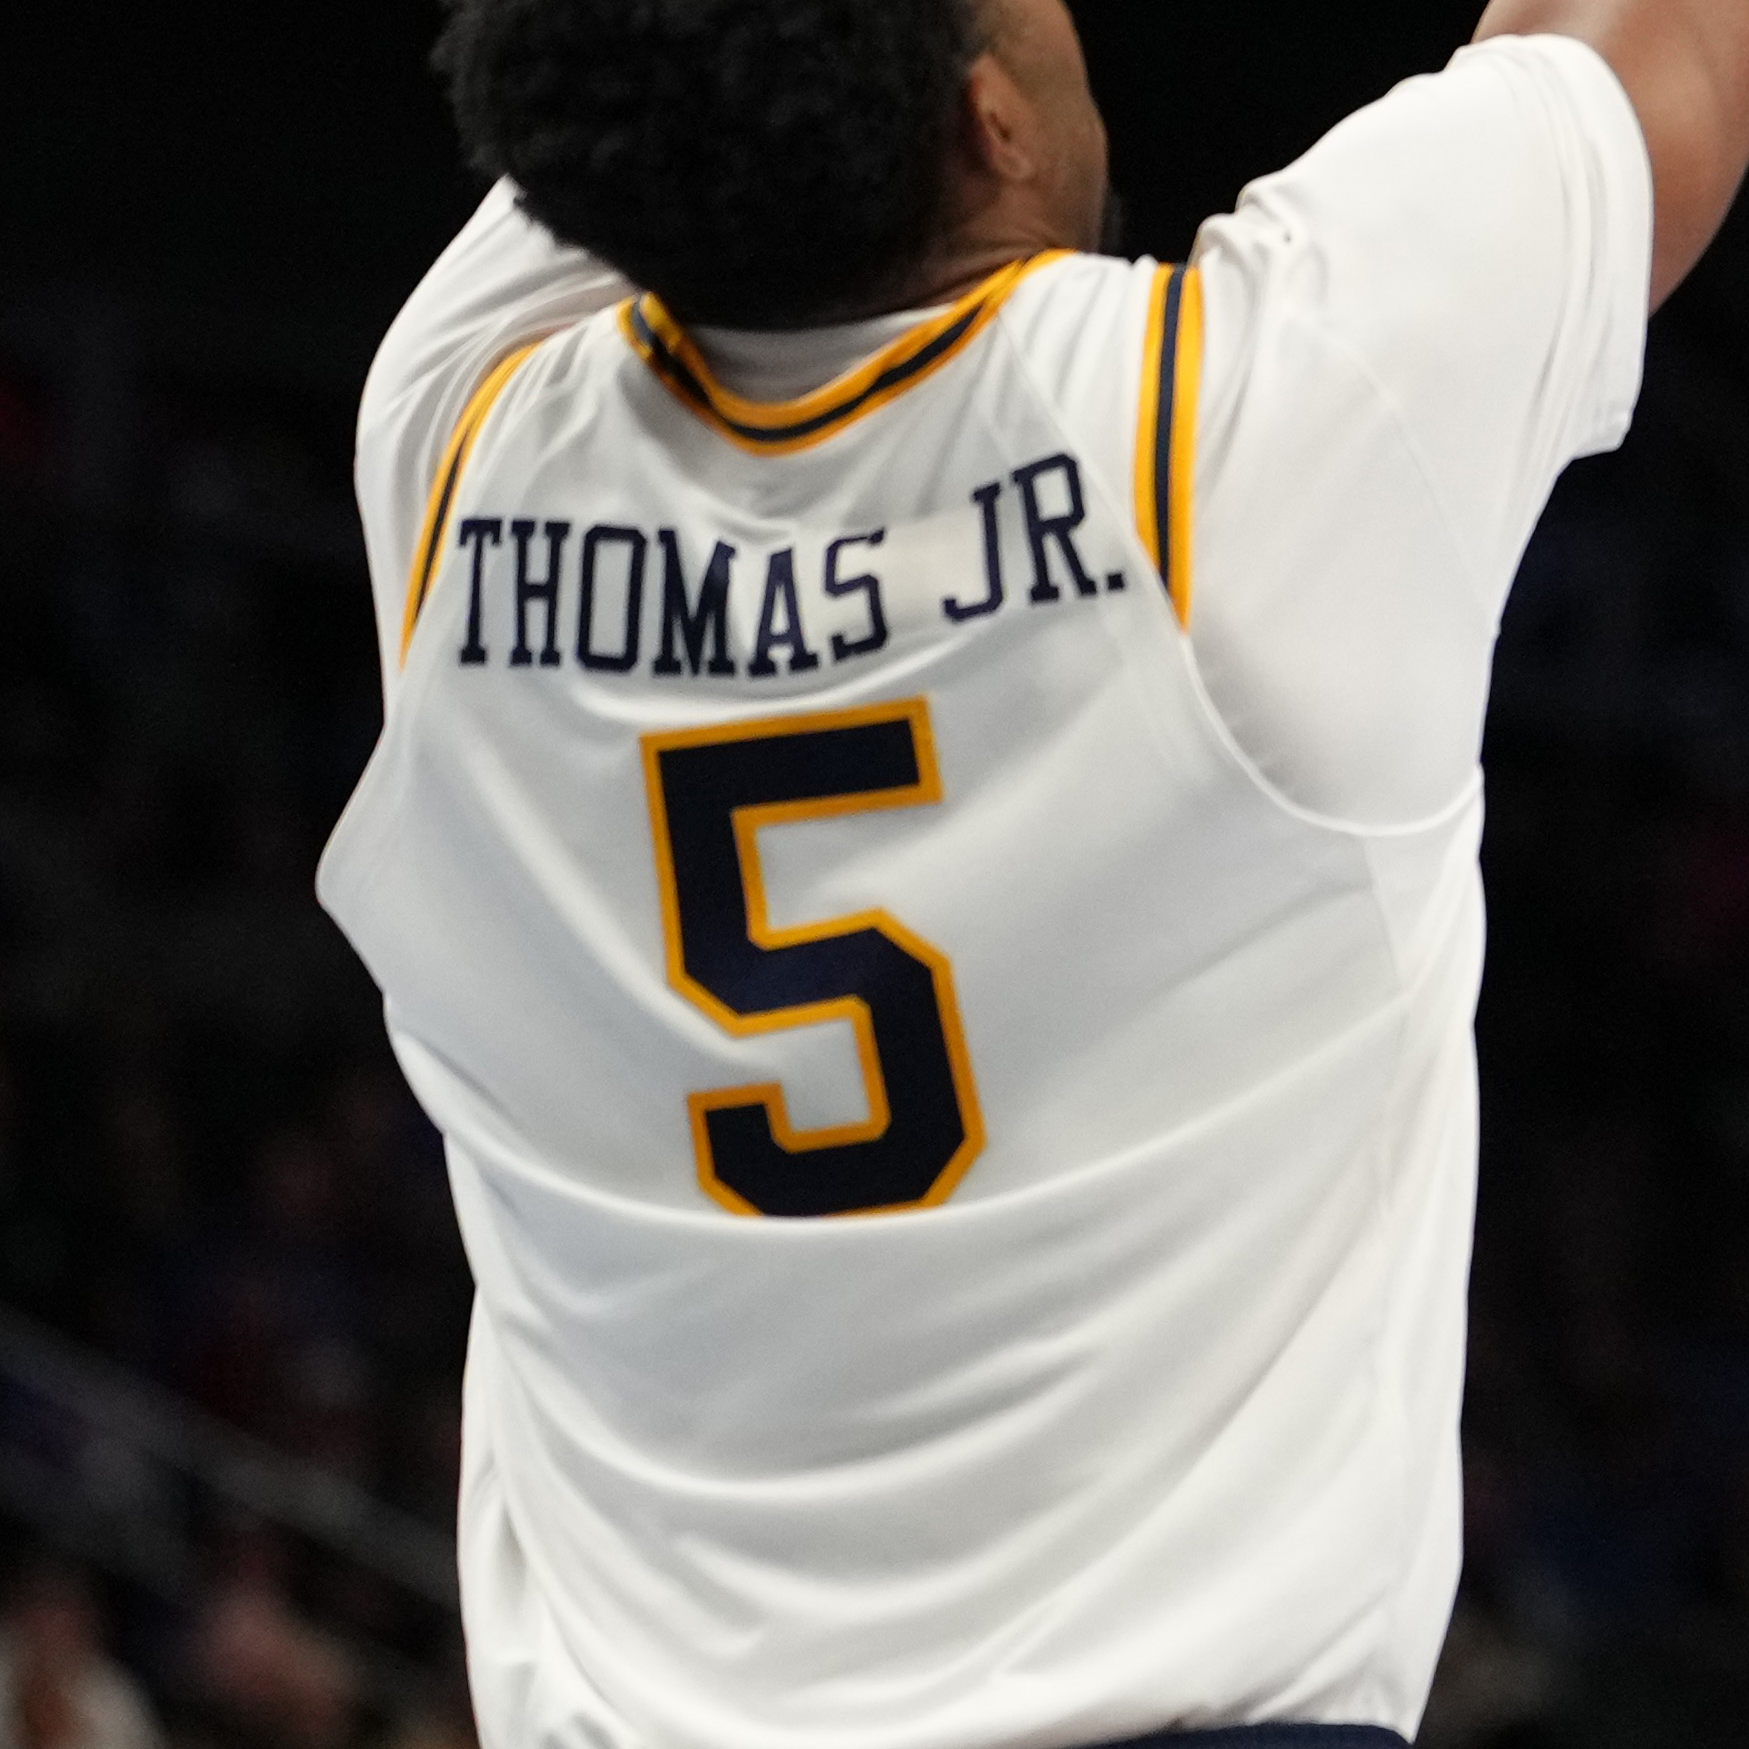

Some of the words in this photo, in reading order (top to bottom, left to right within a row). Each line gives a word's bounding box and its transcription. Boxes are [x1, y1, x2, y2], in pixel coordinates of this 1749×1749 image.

[458, 516, 887, 680] THOMAS
[941, 452, 1127, 626] JR.
[638, 692, 987, 1219] 5
